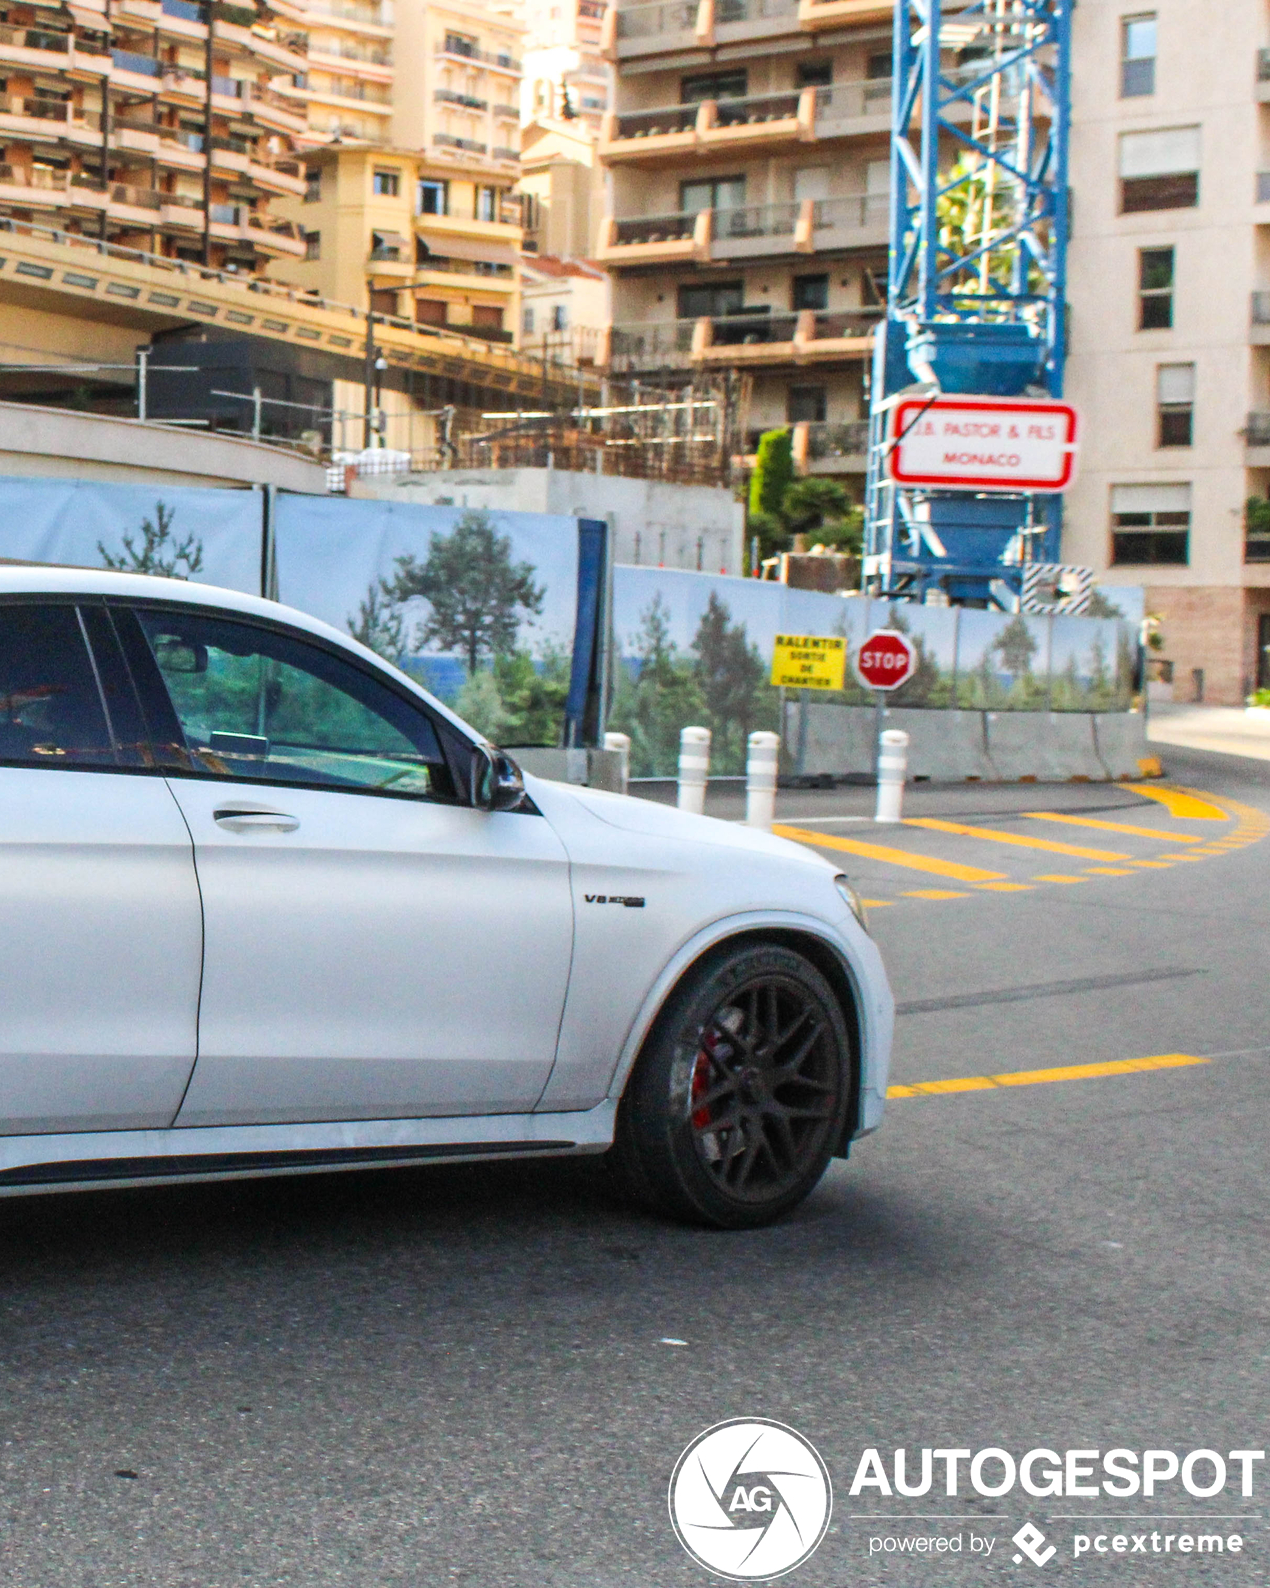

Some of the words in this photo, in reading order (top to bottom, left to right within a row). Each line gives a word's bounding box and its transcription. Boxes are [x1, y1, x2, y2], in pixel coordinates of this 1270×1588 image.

[943, 423, 1001, 438] PASTOR
[1007, 424, 1020, 439] &
[1027, 425, 1055, 440] FILS
[942, 453, 1021, 467] MONACO
[776, 635, 842, 649] RALENTIR
[790, 651, 826, 662] SORTIE
[861, 652, 907, 669] STOP
[800, 664, 813, 673] DE
[781, 675, 831, 686] CHANTIER
[584, 894, 606, 904] V8
